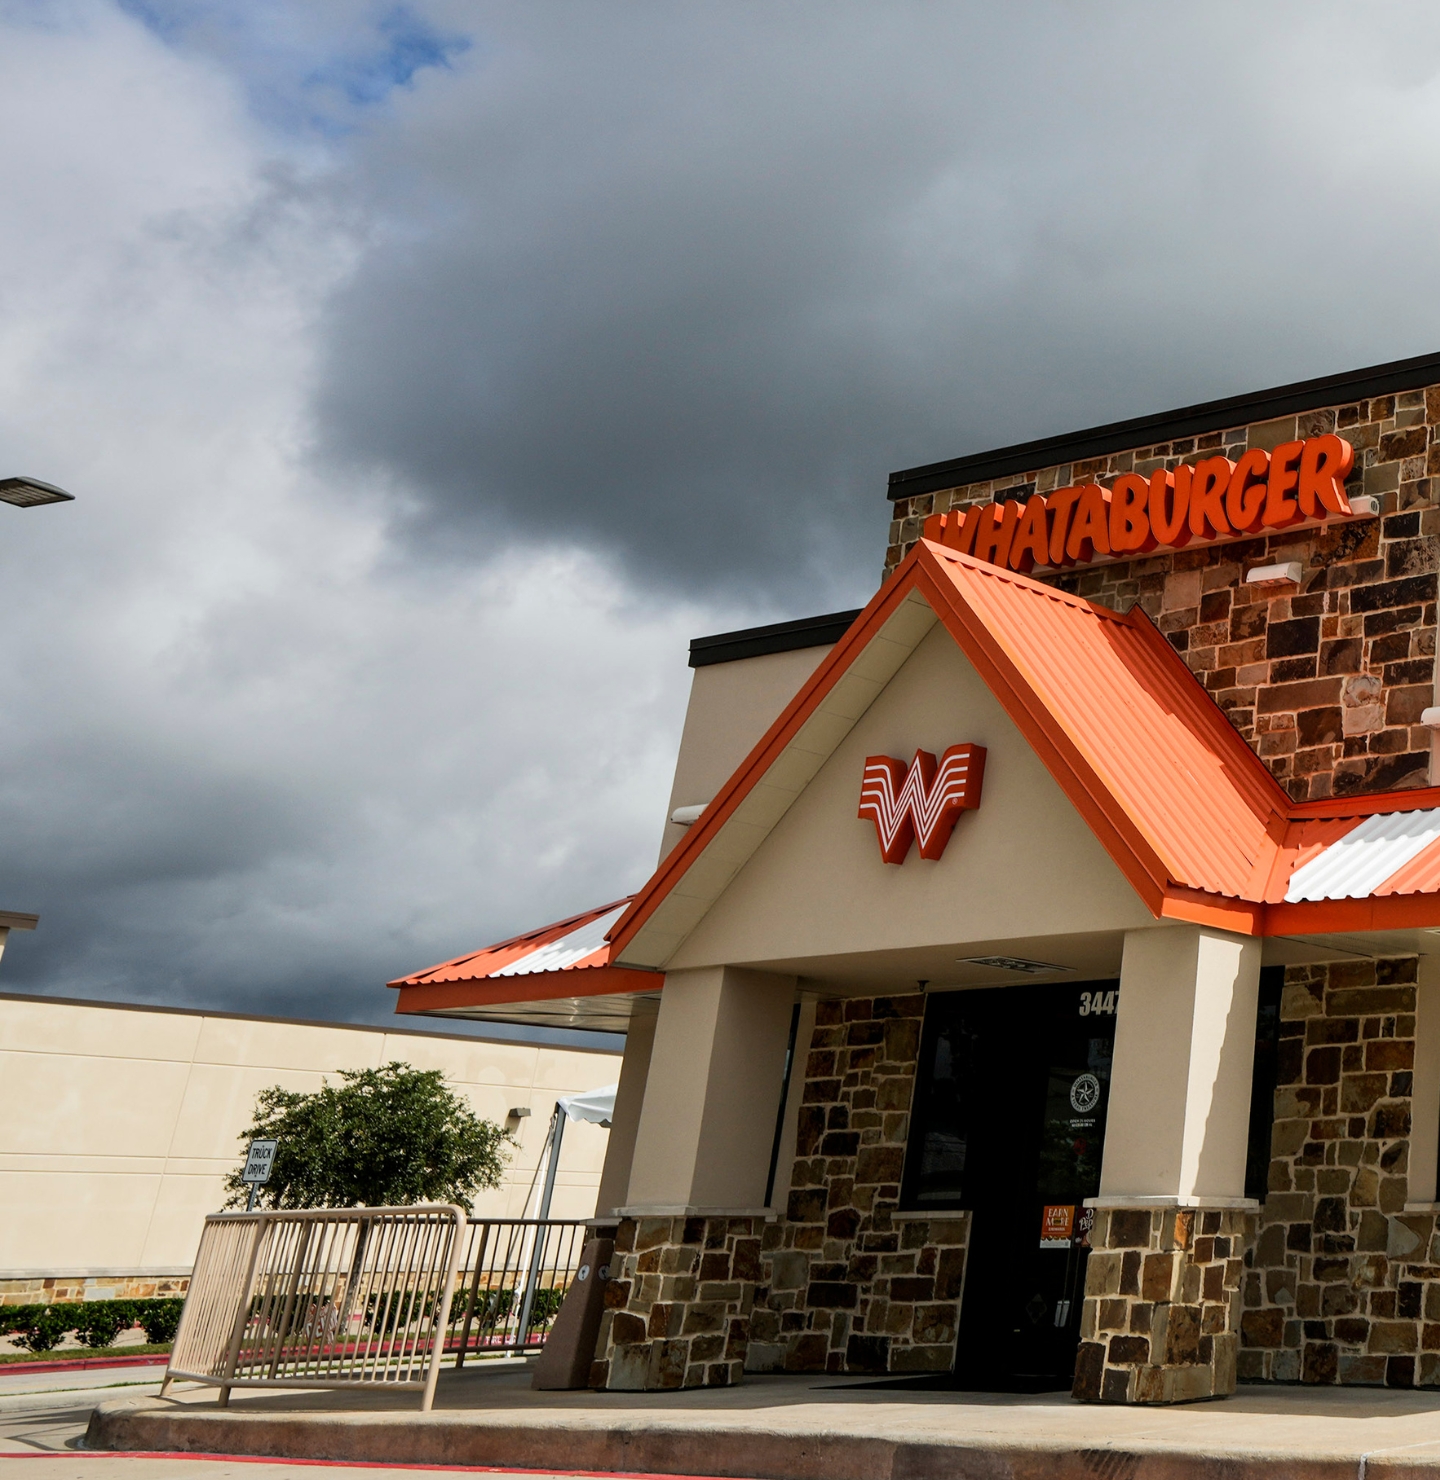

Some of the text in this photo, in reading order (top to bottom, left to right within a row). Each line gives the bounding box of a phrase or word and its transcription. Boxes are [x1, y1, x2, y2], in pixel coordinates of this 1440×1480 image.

[923, 434, 1355, 572] WHATABURGER
[858, 743, 987, 866] W
[251, 1147, 273, 1159] TRUCK
[247, 1163, 267, 1175] DRIVE
[1048, 1208, 1069, 1217] EARN
[1084, 1208, 1094, 1220] D
[1079, 1217, 1094, 1231] Pep
